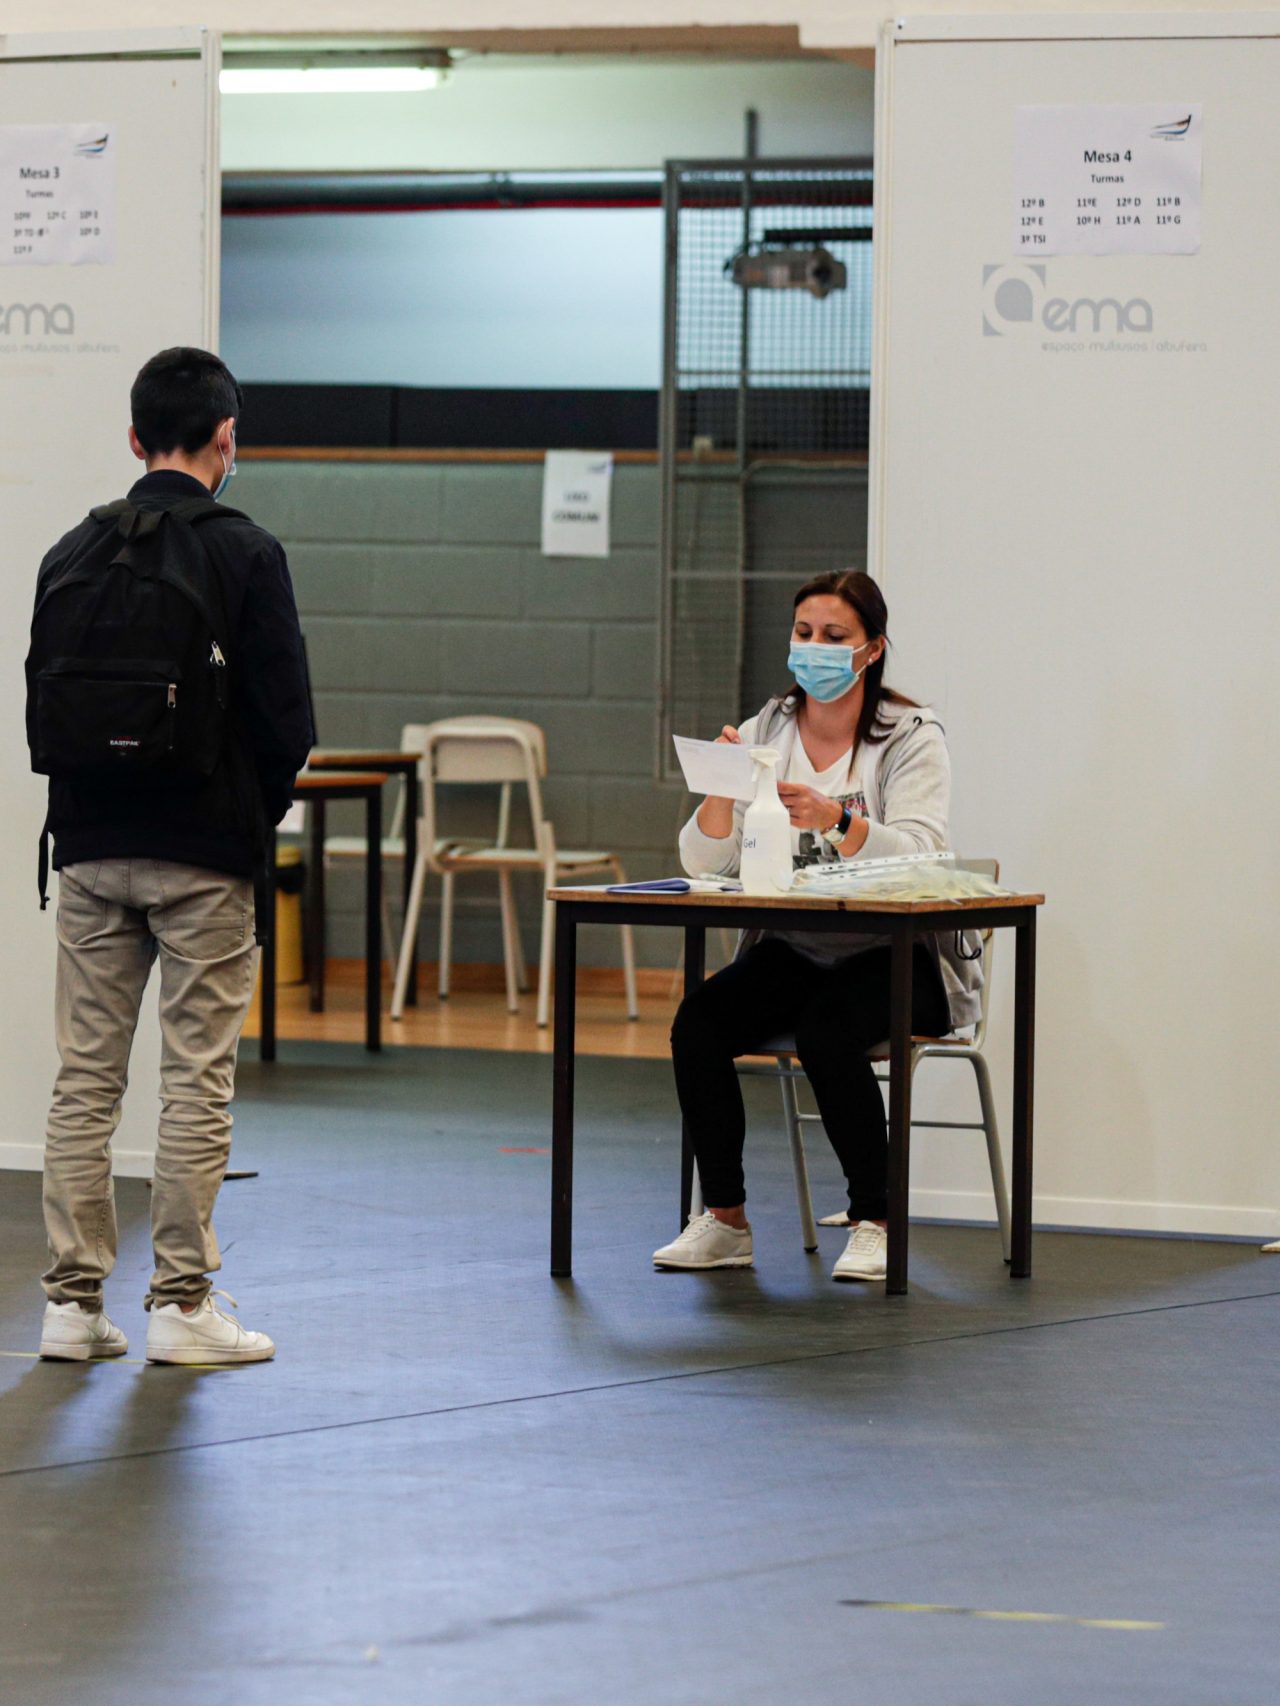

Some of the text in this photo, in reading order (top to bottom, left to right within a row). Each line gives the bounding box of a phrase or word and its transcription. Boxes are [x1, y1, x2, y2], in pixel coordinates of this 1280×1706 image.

[1083, 149, 1132, 163] Mesa 4
[20, 166, 60, 179] Mesa 3
[1090, 174, 1125, 183] Turmas
[1038, 199, 1045, 208] B
[1134, 198, 1141, 207] D
[1174, 197, 1181, 206] B
[1038, 217, 1043, 226] E
[1094, 216, 1101, 225] H
[1133, 216, 1141, 225] A
[1174, 216, 1181, 225] G
[1042, 298, 1153, 333] ema
[743, 837, 756, 848] Gel
